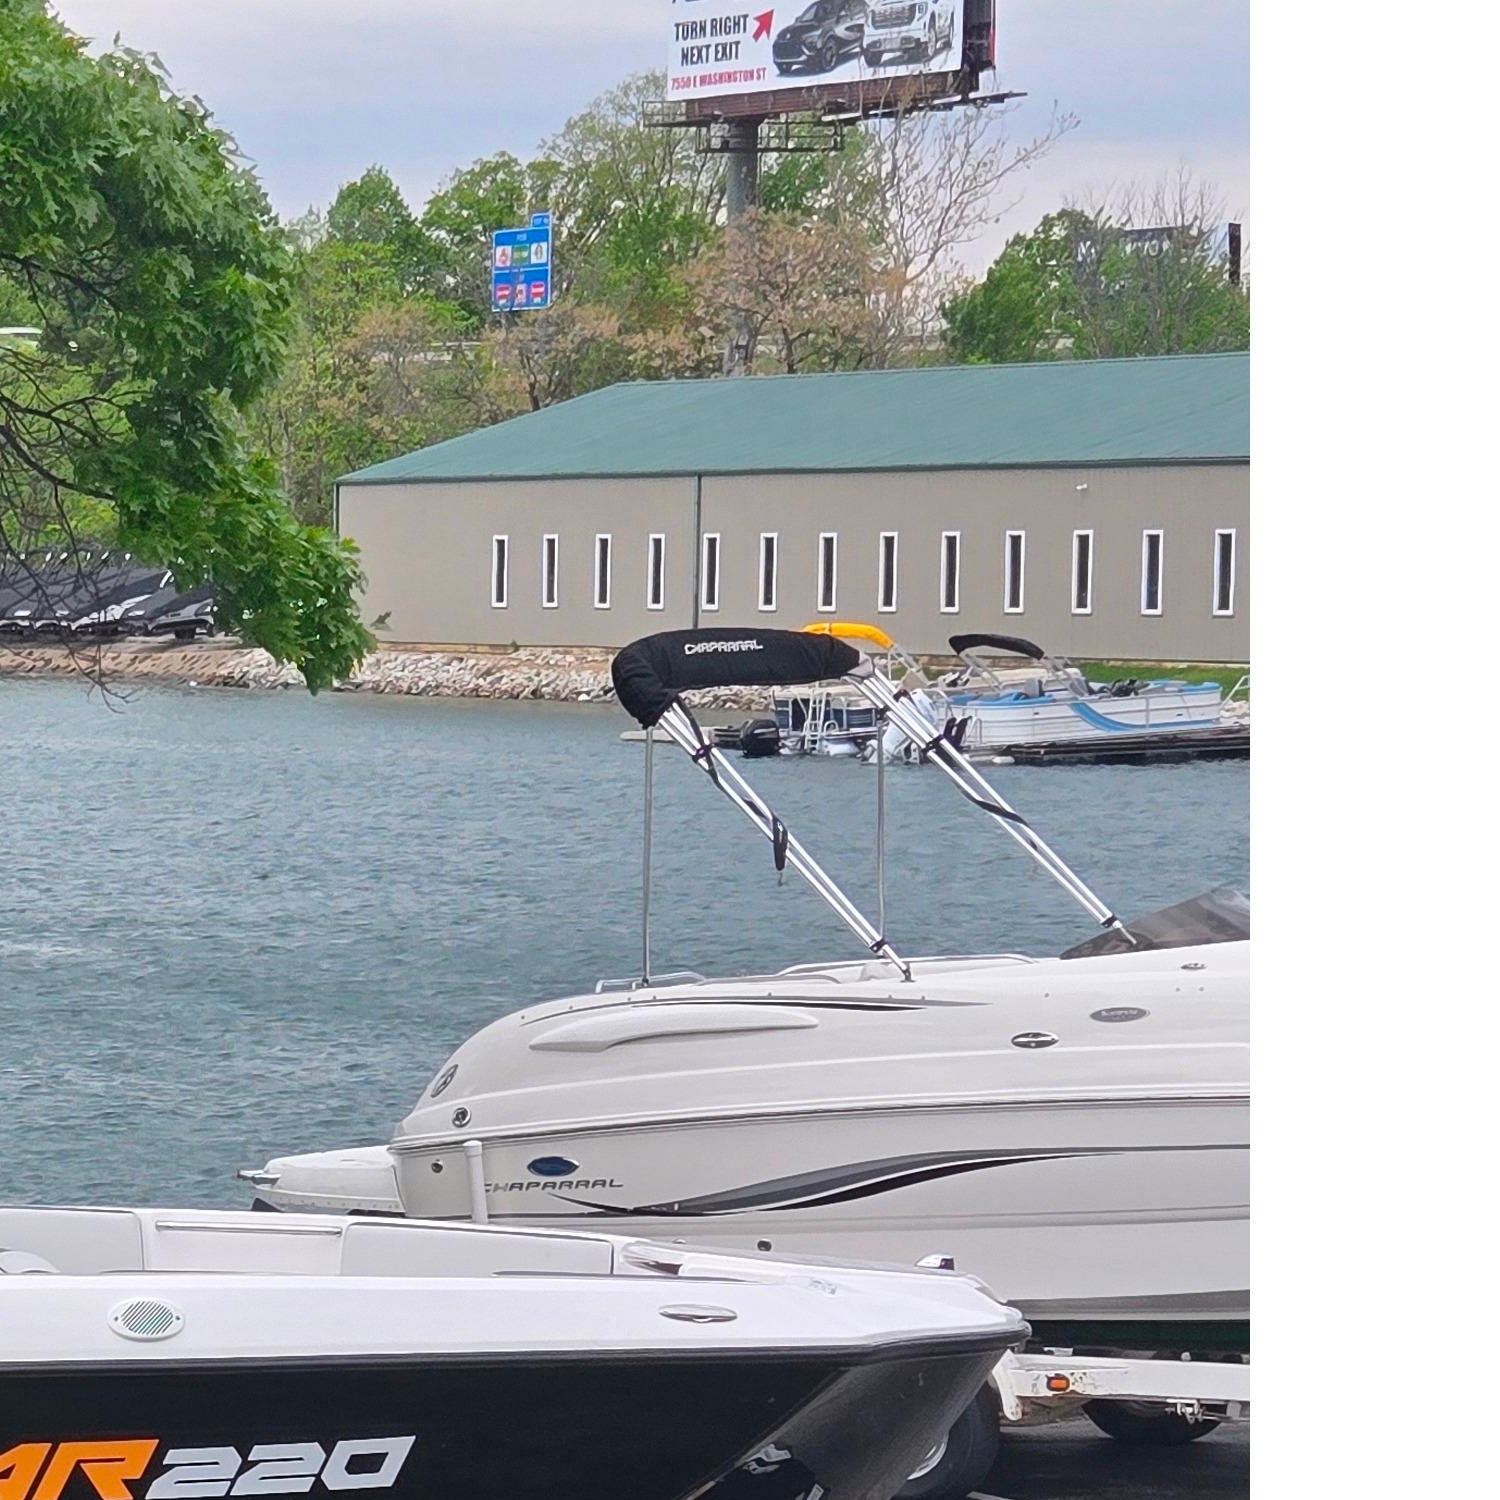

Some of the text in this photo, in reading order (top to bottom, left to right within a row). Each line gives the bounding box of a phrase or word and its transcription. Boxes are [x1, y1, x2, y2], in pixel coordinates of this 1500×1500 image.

[674, 14, 749, 42] TURN RIGHT
[681, 41, 741, 67] NEXT EXIT
[693, 75, 699, 88] E
[699, 69, 754, 87] WASHINGTON
[755, 67, 767, 81] ST
